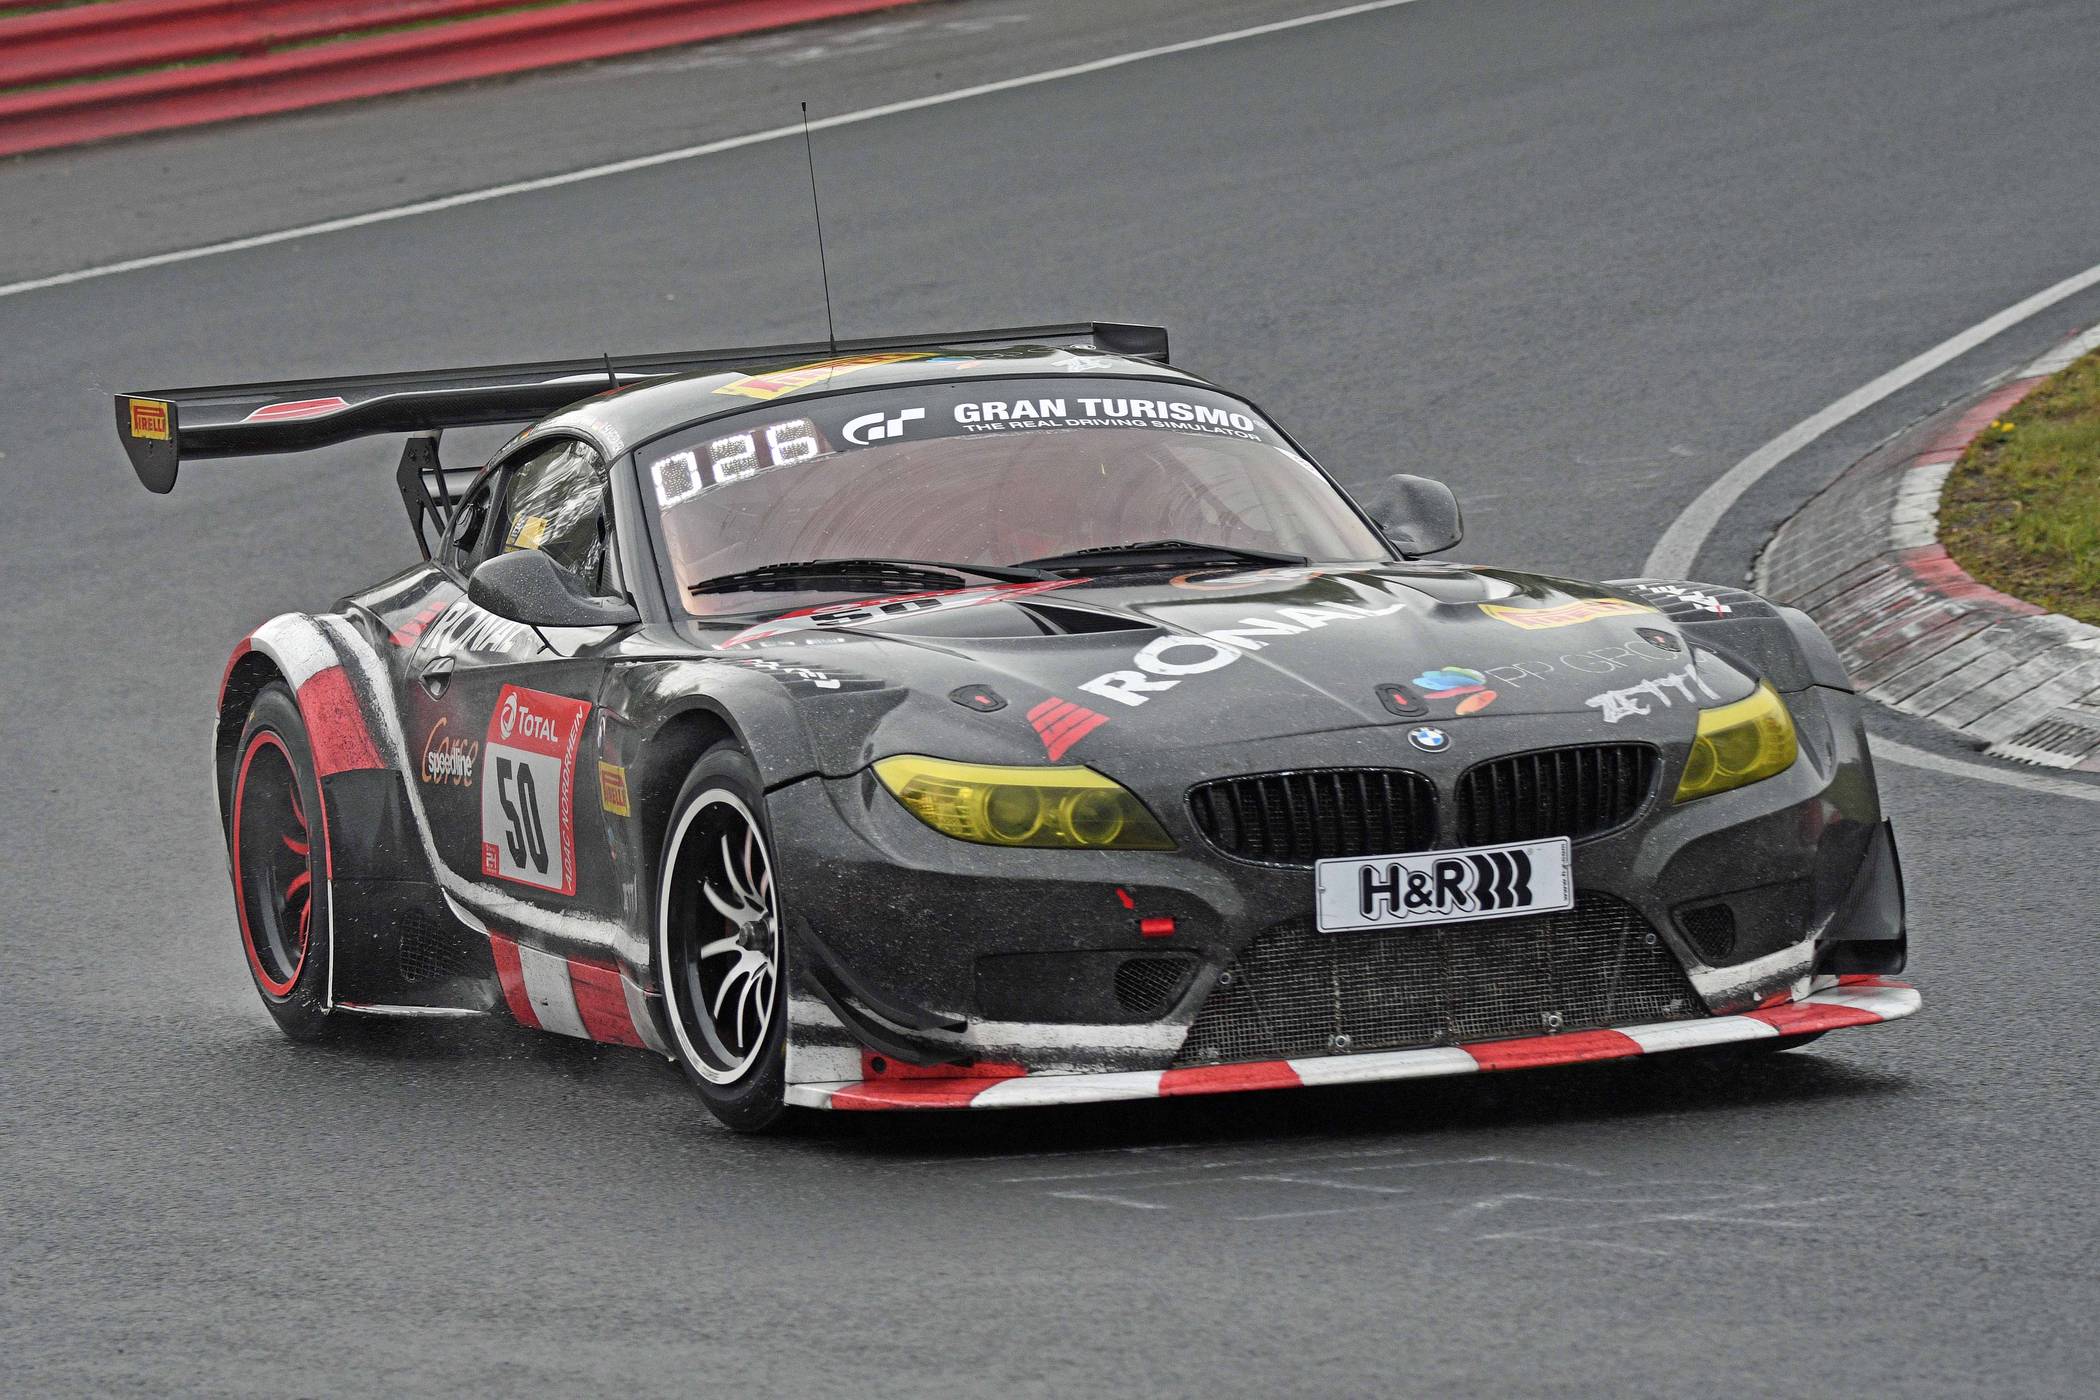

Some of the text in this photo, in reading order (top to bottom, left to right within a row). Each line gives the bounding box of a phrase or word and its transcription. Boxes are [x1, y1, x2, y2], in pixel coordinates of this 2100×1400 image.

[133, 405, 166, 433] PIRELLI
[953, 398, 1256, 432] GRAN TURISMO
[963, 418, 1263, 443] THE REAL DRIVING SIMULATOR
[651, 418, 819, 507] 026
[422, 601, 527, 657] RONAL
[1077, 600, 1407, 707] RONAL
[1485, 660, 1555, 688] PP
[518, 706, 559, 743] TOTAL
[428, 747, 473, 779] speedline
[496, 756, 549, 875] 50
[561, 705, 583, 891] ADAC NORDRHEIN
[1359, 857, 1476, 921] H&R
